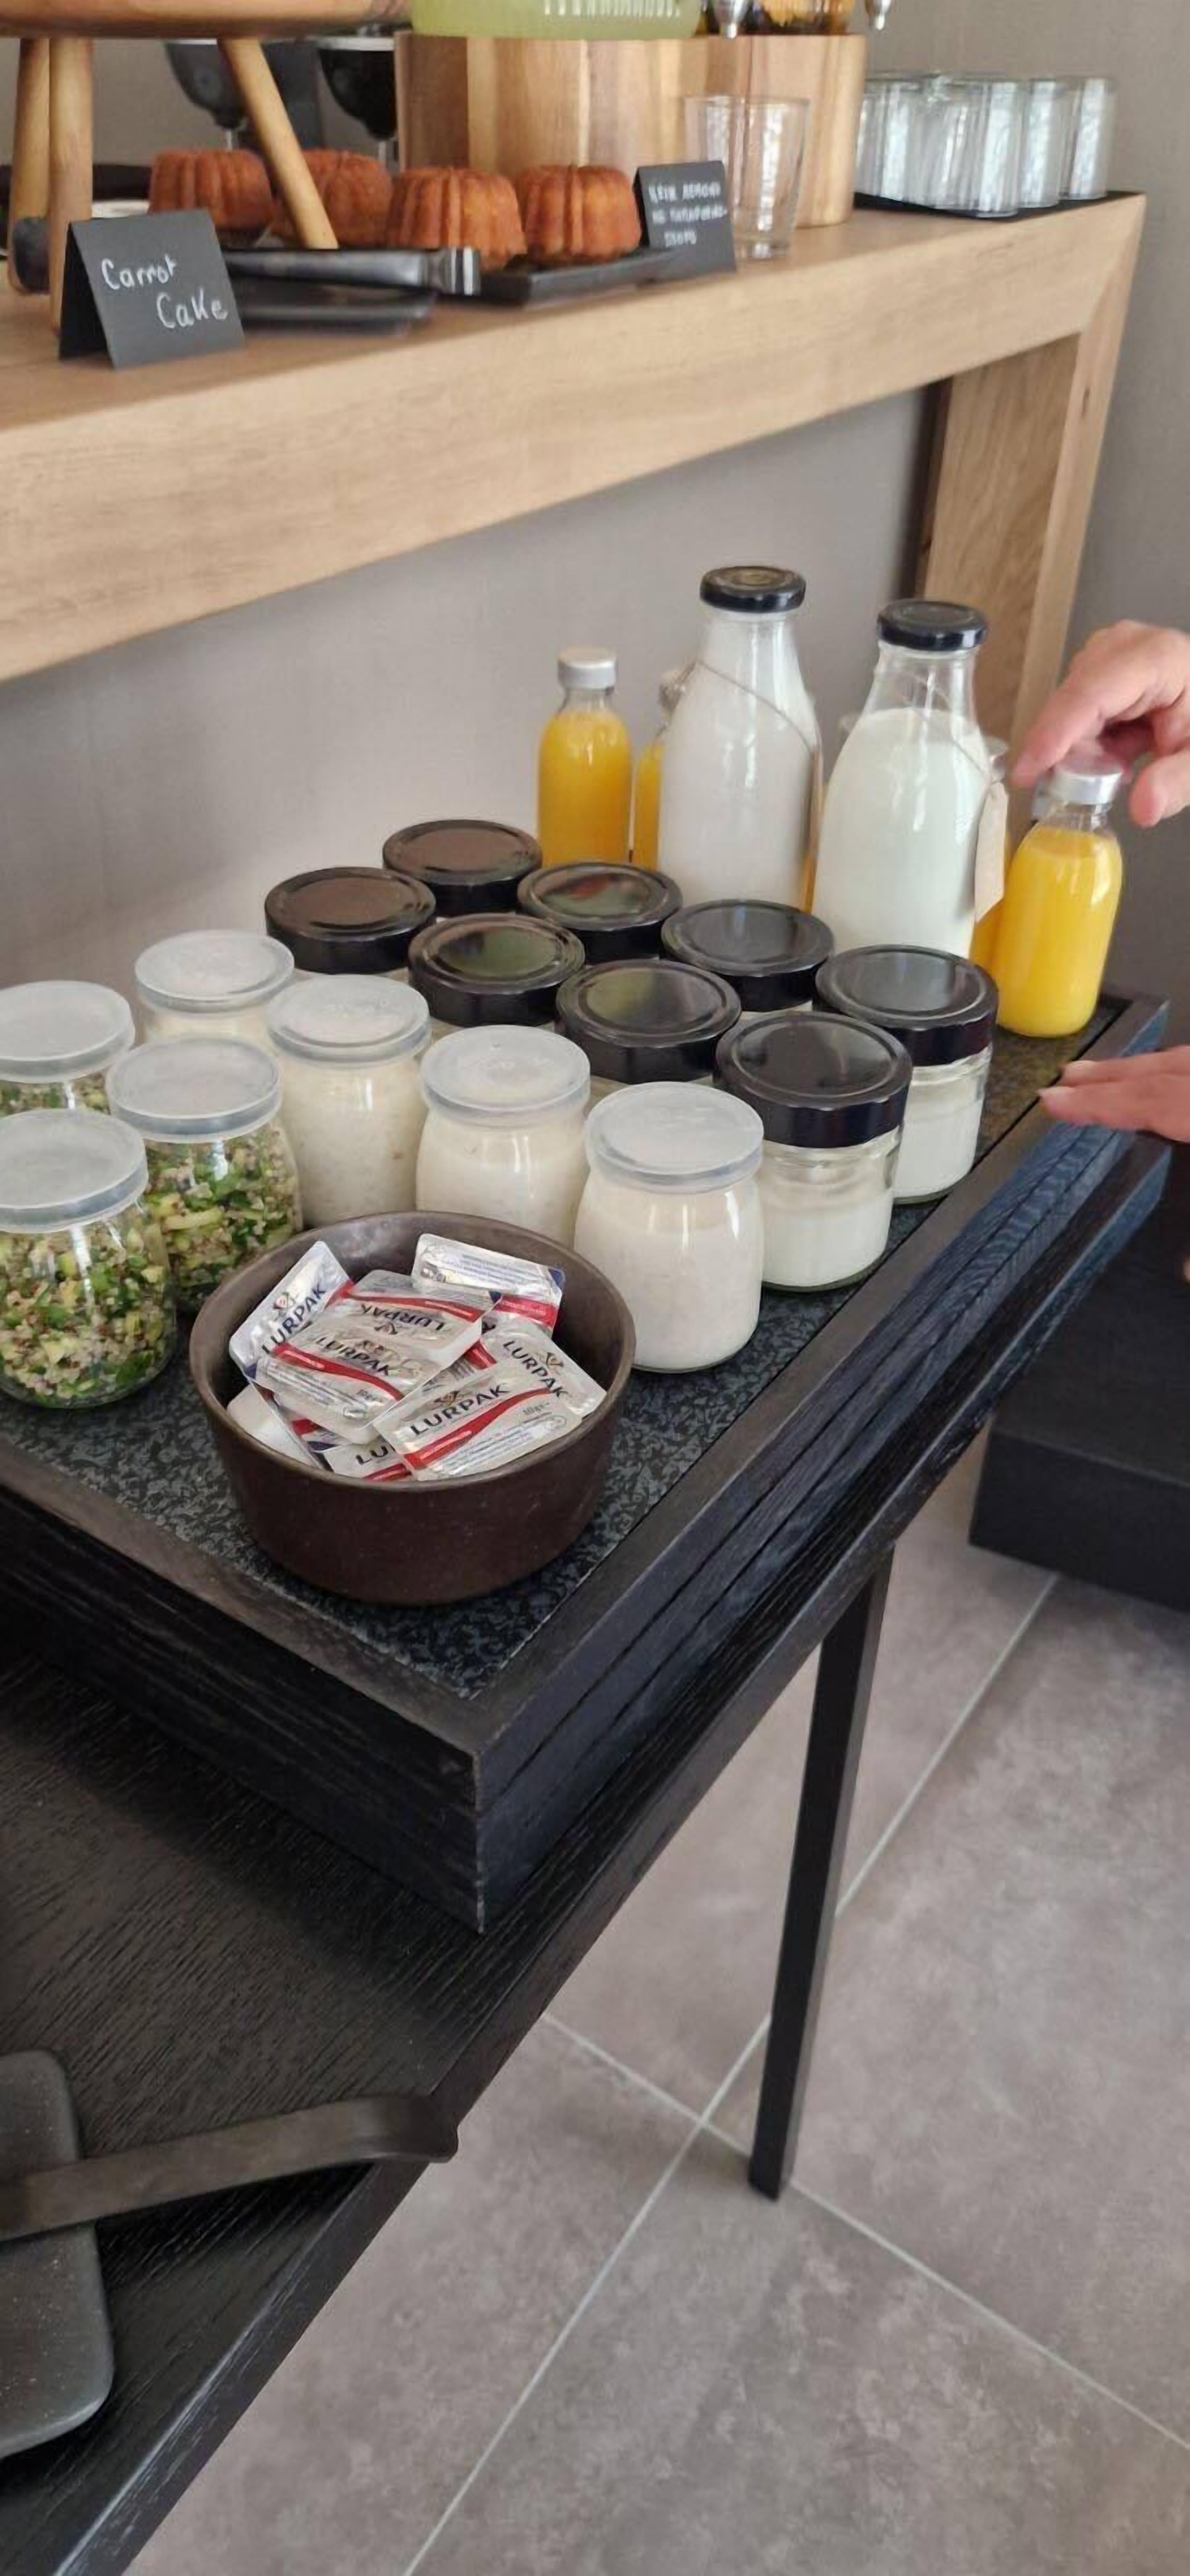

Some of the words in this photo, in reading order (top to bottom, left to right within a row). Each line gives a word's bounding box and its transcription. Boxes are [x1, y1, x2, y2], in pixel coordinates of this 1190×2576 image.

[101, 254, 177, 290] Carrot
[361, 1303, 446, 1331] LURPAK
[316, 1336, 389, 1376] LURPAK
[503, 1340, 569, 1398] LURPAK
[410, 1383, 510, 1436] LURPAK
